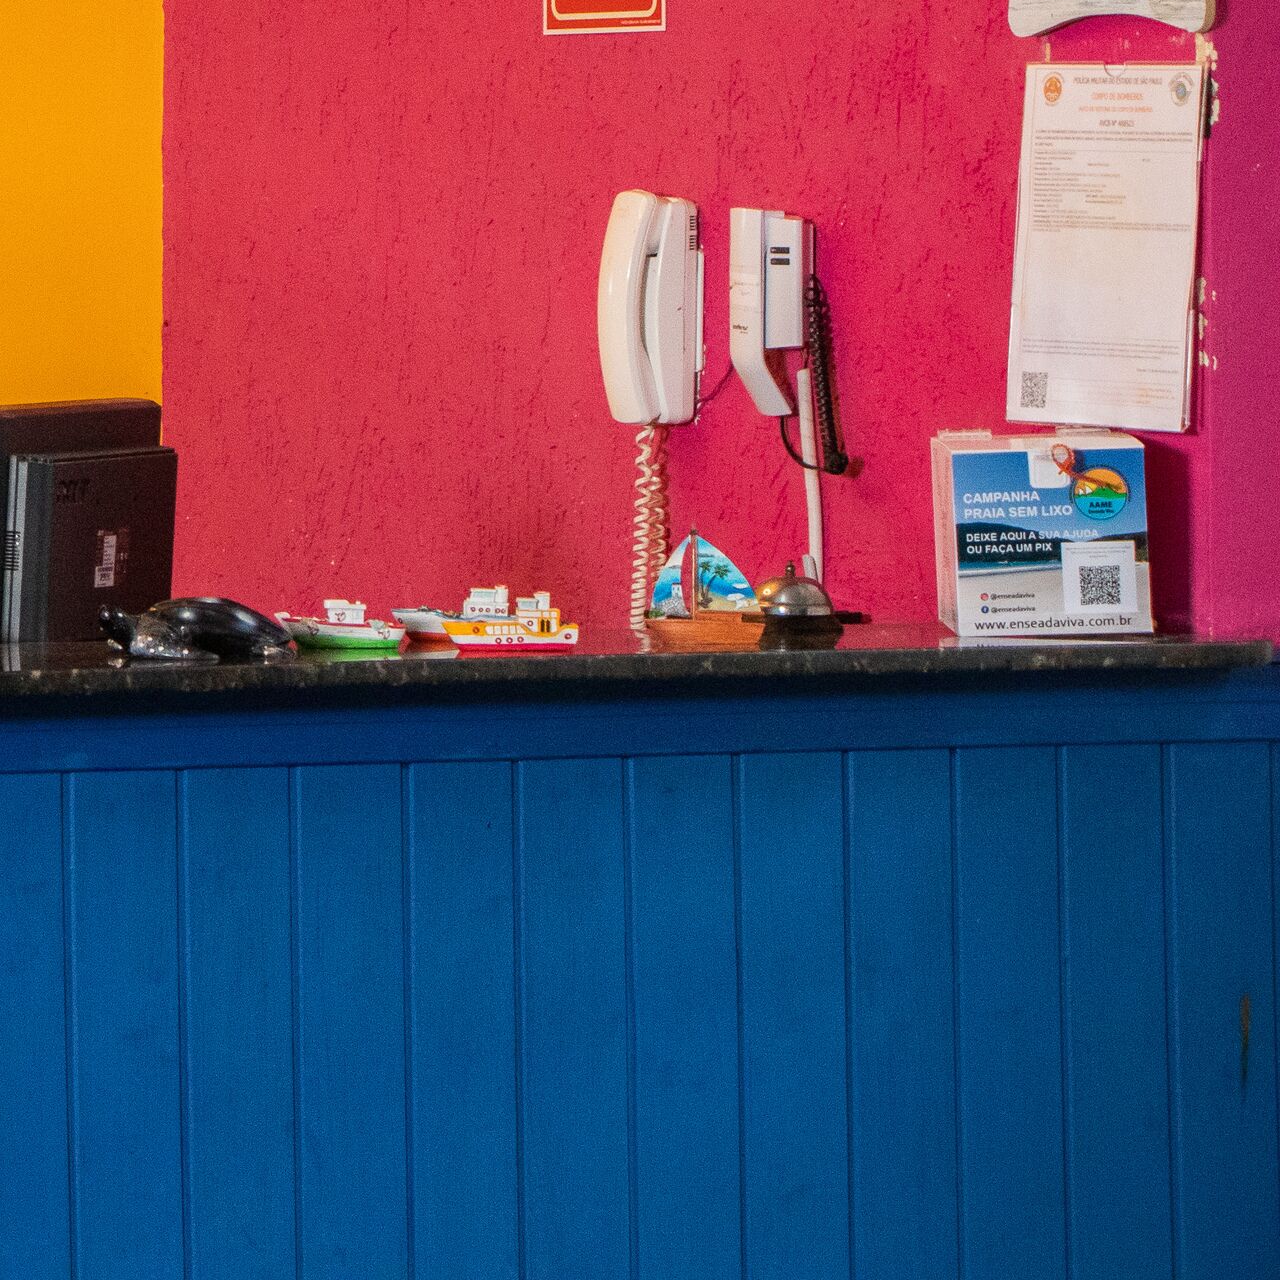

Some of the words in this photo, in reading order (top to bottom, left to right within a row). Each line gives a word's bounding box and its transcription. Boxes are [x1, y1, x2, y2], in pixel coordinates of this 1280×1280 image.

[963, 491, 1040, 504] CAMPANHA
[964, 508, 1005, 519] PRAIA
[1009, 507, 1037, 517] SEM
[1042, 505, 1072, 516] LIXO
[966, 533, 997, 542] DEIXE
[1000, 532, 1026, 541] AQUI
[1028, 531, 1036, 540] A
[1039, 531, 1060, 539] SUA
[1062, 529, 1099, 538] AJUDA
[967, 545, 982, 554] OU
[985, 544, 1013, 555] FAÇA
[1016, 544, 1032, 552] UM
[1035, 543, 1052, 551] PIX
[991, 592, 1035, 601] @enseadaviva
[991, 606, 1036, 614] @enseadaviva
[974, 615, 1133, 630] www.enseadaviva.com.br
